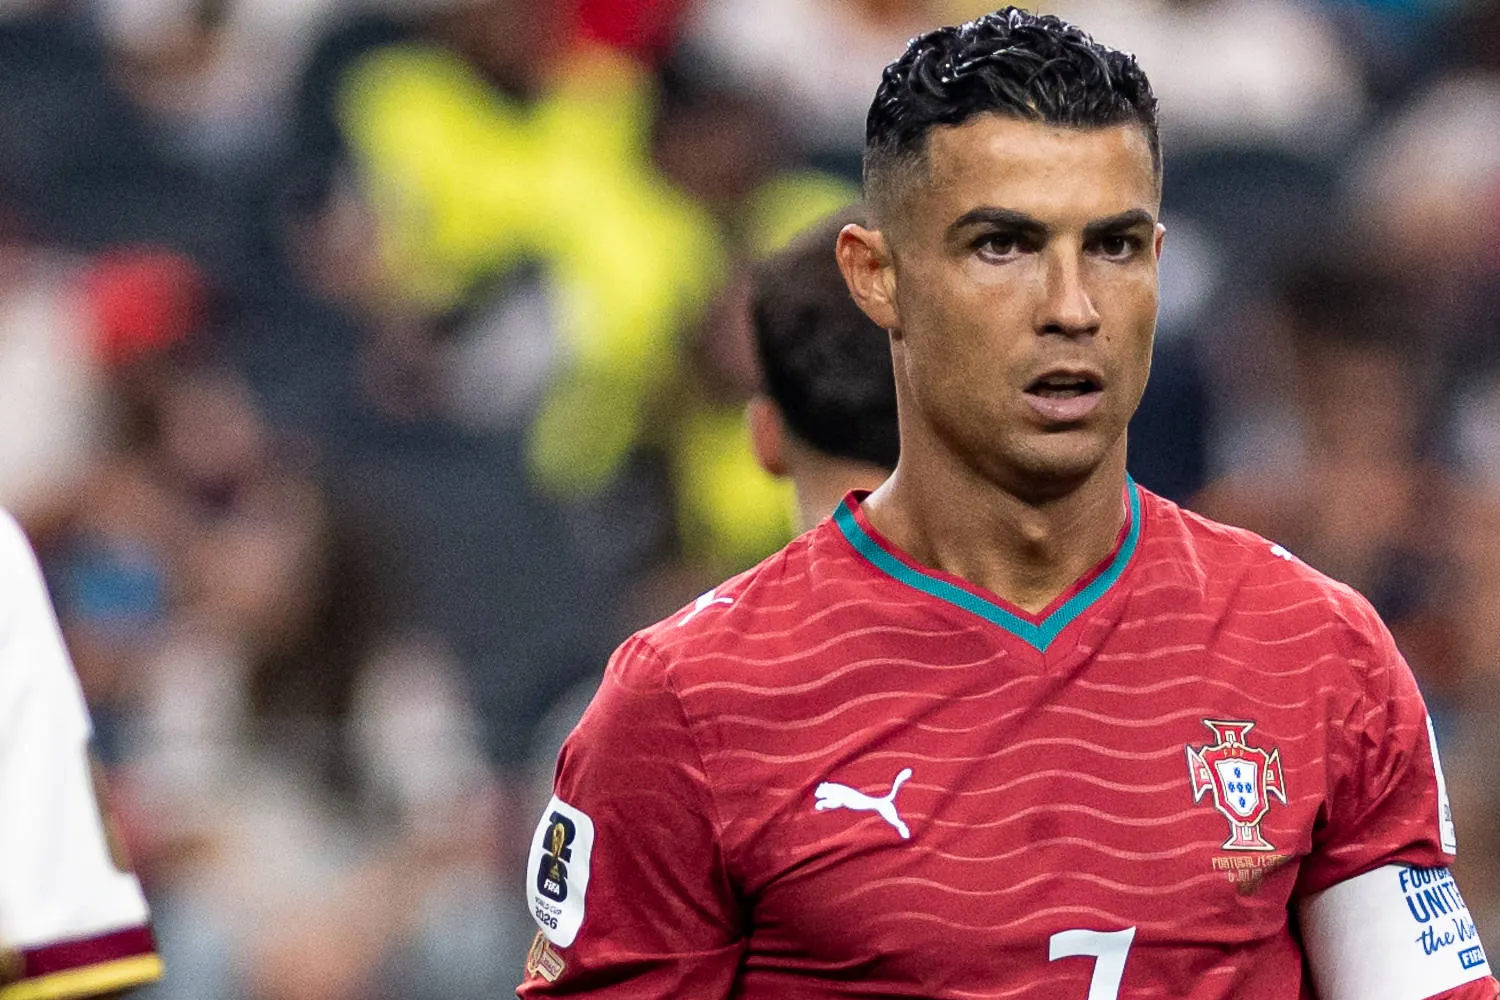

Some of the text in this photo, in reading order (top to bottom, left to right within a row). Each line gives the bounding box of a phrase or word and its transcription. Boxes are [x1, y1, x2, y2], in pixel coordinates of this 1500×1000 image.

[543, 878, 560, 896] FIFA
[535, 907, 559, 930] 2026
[1415, 925, 1455, 956] the
